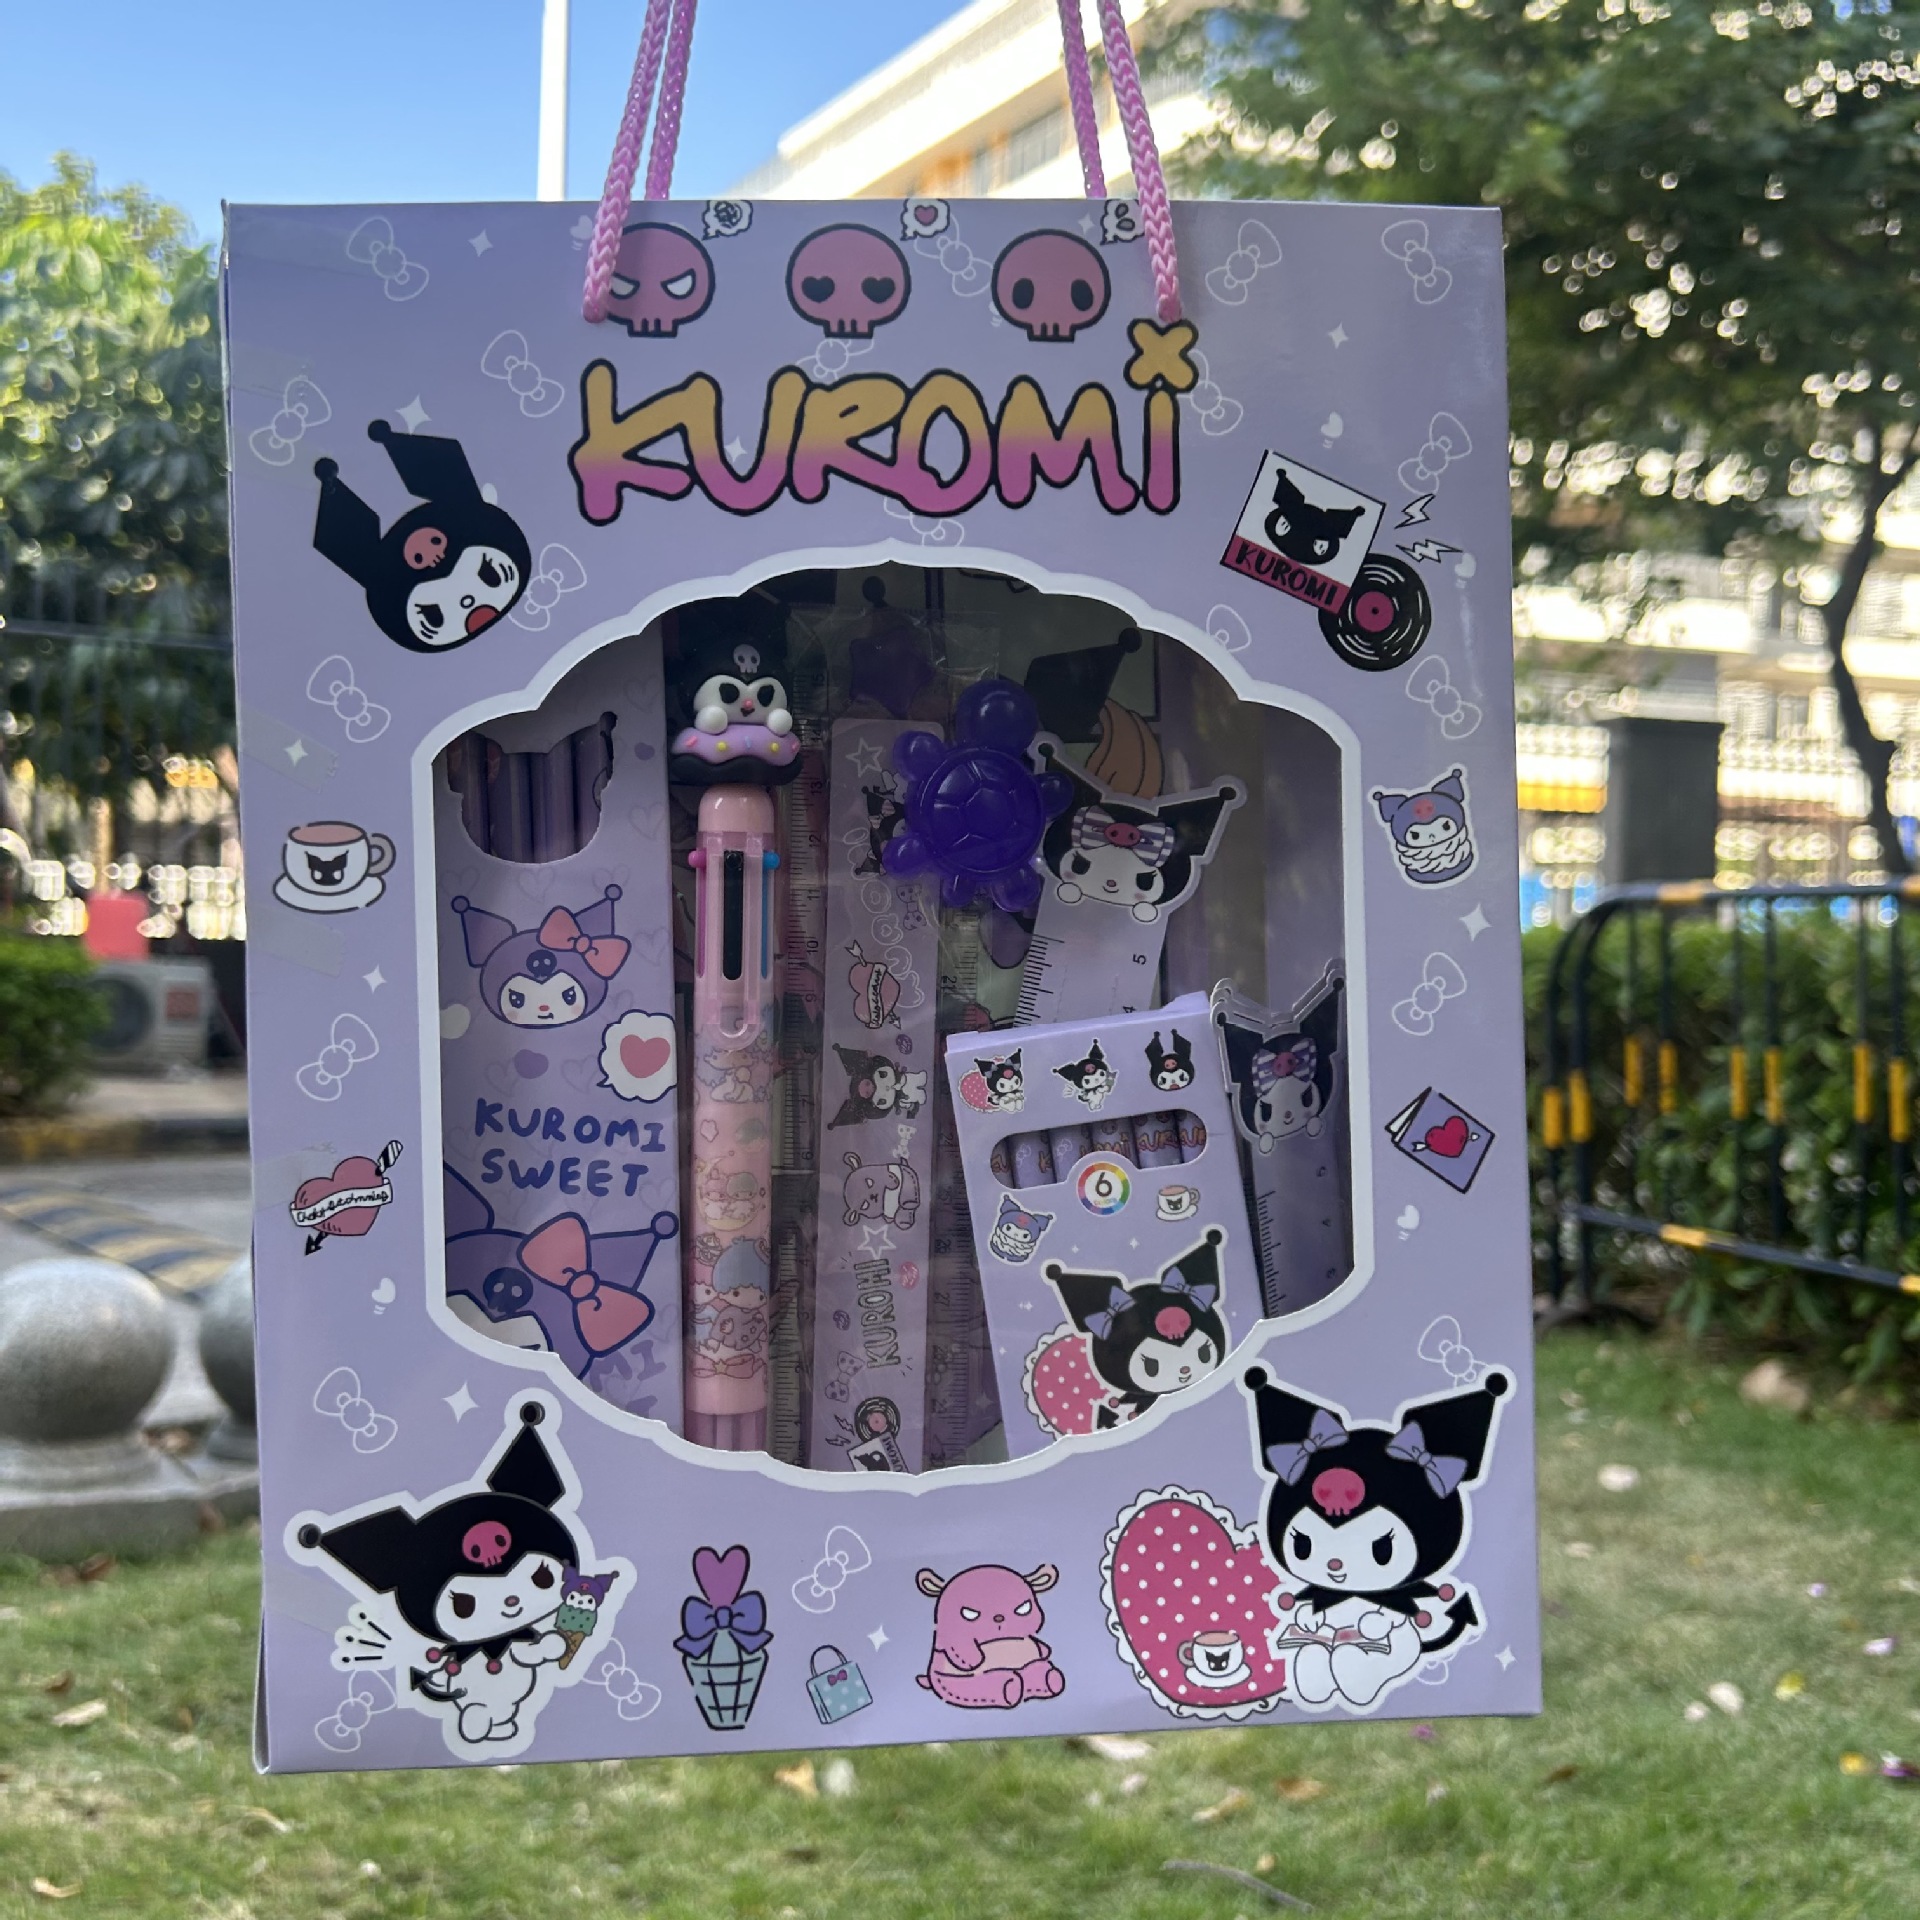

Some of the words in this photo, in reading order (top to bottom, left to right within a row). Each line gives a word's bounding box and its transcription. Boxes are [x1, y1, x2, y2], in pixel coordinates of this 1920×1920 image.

[1235, 541, 1338, 607] KUROMI
[808, 833, 821, 848] 12
[806, 940, 819, 955] 10
[1132, 953, 1147, 965] 5
[475, 1098, 666, 1153] KUROMI
[481, 1148, 649, 1197] SWEET
[1094, 1171, 1113, 1198] 6
